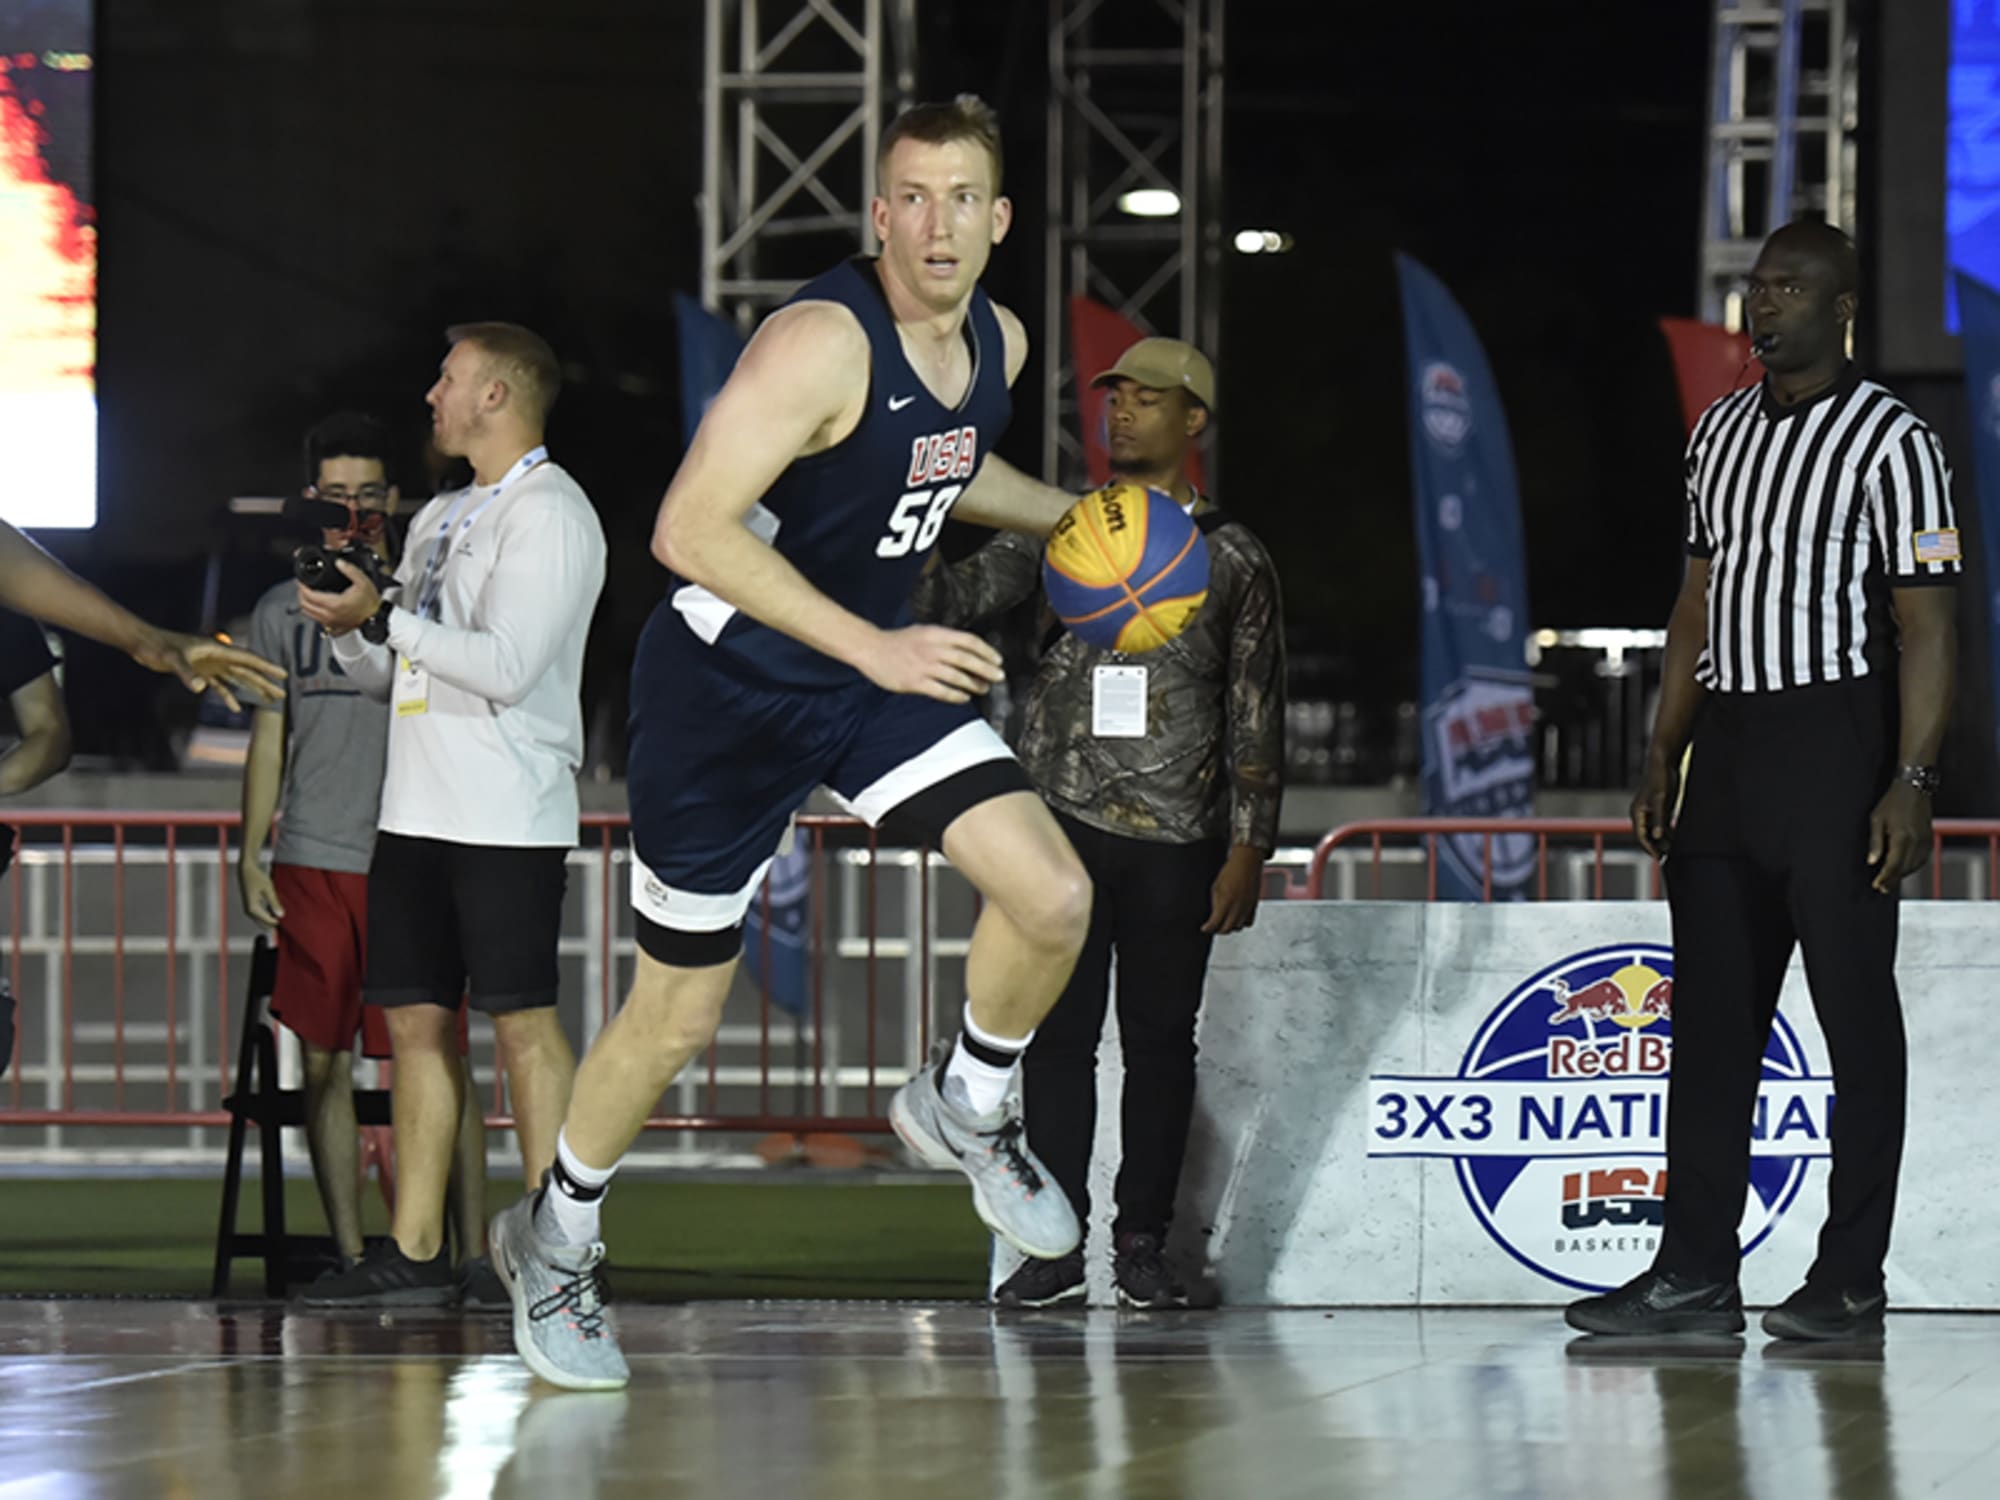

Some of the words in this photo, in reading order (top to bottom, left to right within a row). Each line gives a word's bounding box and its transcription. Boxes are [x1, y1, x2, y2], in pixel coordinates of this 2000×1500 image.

[907, 426, 976, 488] USA
[876, 485, 962, 558] 58
[1551, 1035, 1630, 1075] Red
[1375, 1093, 1493, 1139] 3X3
[1554, 1237, 1656, 1254] BASKETB
